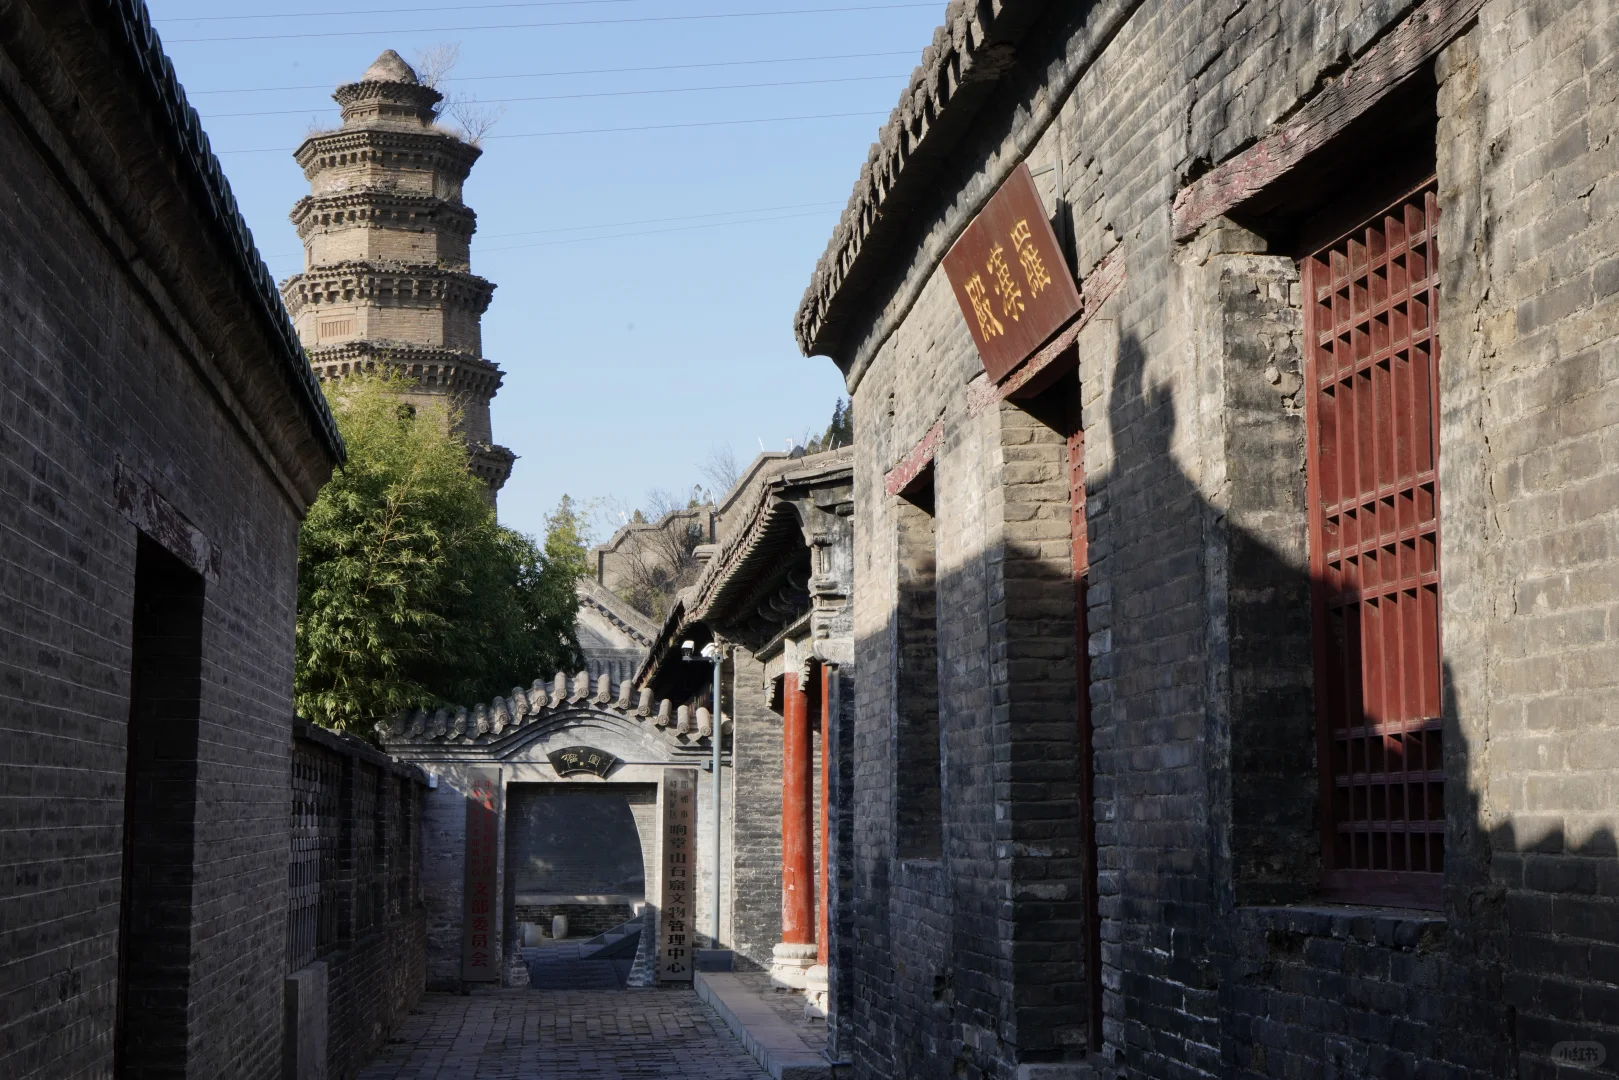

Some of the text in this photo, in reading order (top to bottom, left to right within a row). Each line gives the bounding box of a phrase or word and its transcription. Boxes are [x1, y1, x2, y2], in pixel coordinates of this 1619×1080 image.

[964, 219, 1051, 343] 羅漢殿
[471, 881, 489, 968] 支部委员会
[667, 824, 687, 974] 响堂山石窟文物管理中心
